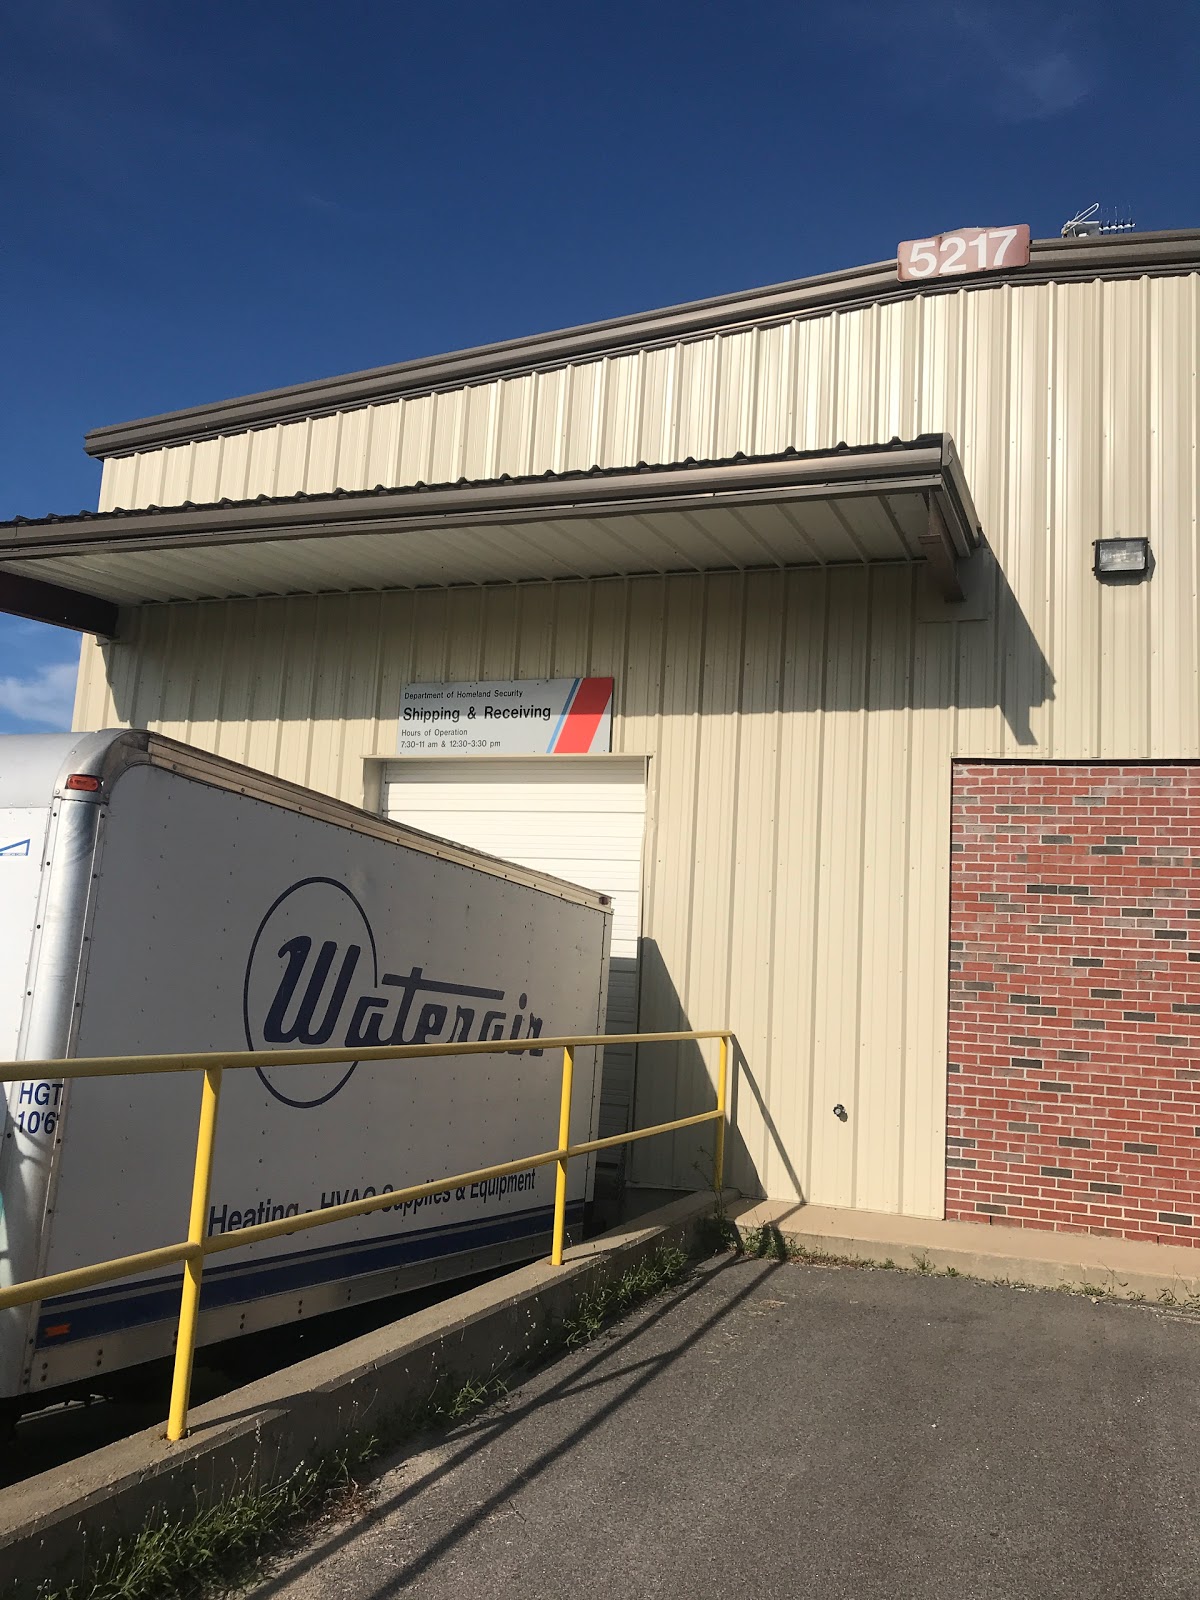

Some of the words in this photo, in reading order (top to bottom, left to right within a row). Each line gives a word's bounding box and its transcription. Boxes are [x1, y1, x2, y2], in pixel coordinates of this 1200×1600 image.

[908, 228, 1018, 277] 5217
[404, 691, 444, 701] Department
[446, 690, 454, 699] of
[456, 689, 491, 698] Homeland
[493, 688, 524, 698] Security
[403, 706, 460, 723] Shipping
[467, 706, 477, 720] &
[484, 705, 551, 721] Receiving
[401, 729, 421, 737] Hours
[424, 728, 431, 737] of
[434, 728, 468, 738] Operation
[401, 740, 425, 748] 7:30-11
[441, 740, 447, 748] &
[449, 739, 487, 748] 12:30-3:30
[489, 740, 501, 749] pm
[208, 1198, 300, 1236] Heating
[470, 1168, 536, 1204] Equipment
